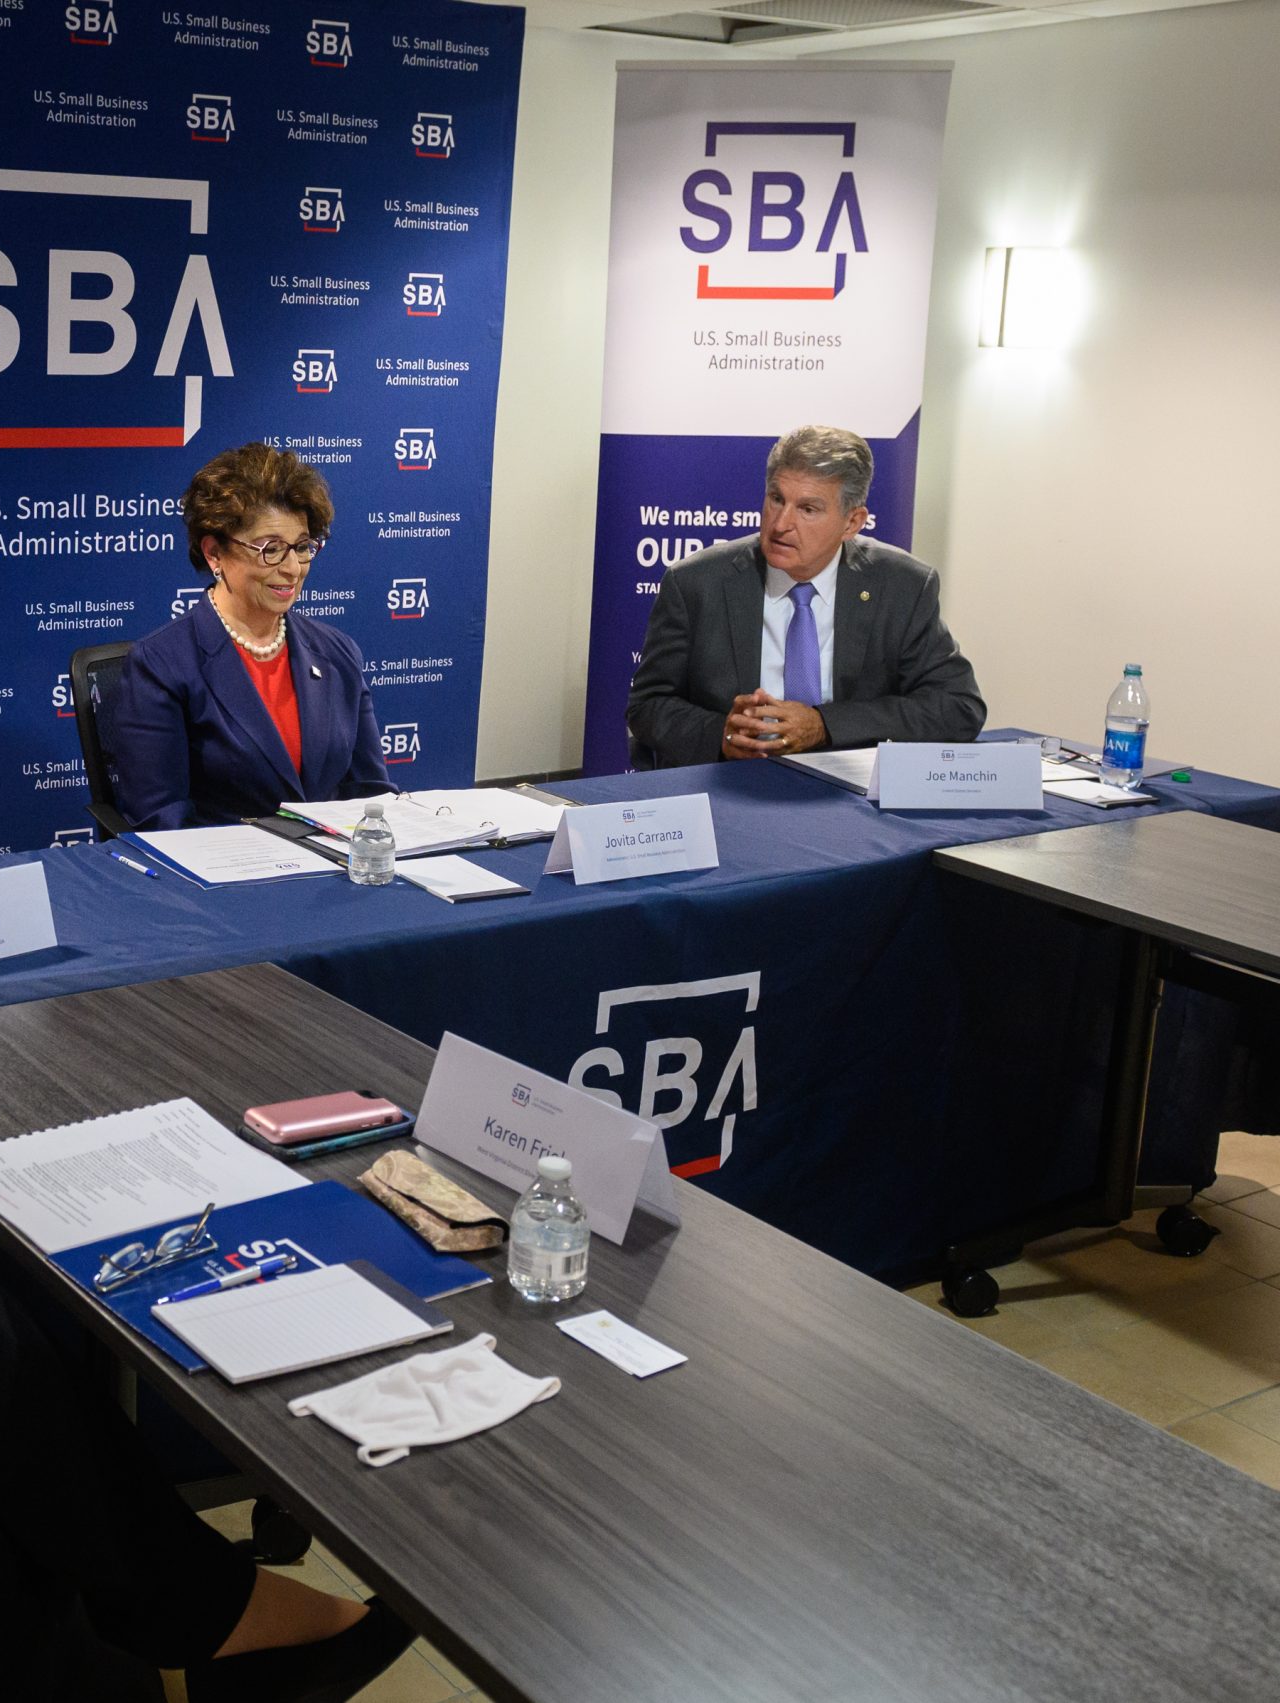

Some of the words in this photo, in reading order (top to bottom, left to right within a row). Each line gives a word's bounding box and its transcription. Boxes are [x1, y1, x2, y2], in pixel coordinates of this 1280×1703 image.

[65, 6, 118, 34] SBA
[306, 30, 353, 57] SBA
[34, 90, 55, 104] U.S.
[59, 92, 92, 106] Small
[96, 95, 148, 110] Business
[46, 110, 136, 127] Administration
[186, 105, 235, 132] SBA
[411, 124, 456, 148] SBA
[298, 198, 345, 222] SBA
[384, 200, 402, 211] U.S.
[405, 201, 433, 213] Small
[436, 202, 479, 216] Business
[680, 169, 869, 253] SBA
[394, 217, 468, 232] Administration
[270, 276, 289, 287] U.S.
[292, 276, 322, 288] Small
[325, 277, 370, 290] Business
[281, 292, 359, 306] Administration
[402, 284, 446, 308] SBA
[694, 330, 719, 346] U.S.
[725, 330, 768, 346] Small
[774, 331, 842, 347] Business
[376, 358, 394, 370] U.S.
[396, 358, 424, 370] Small
[427, 359, 469, 371] Business
[708, 354, 824, 370] Administration
[292, 360, 338, 384] SBA
[386, 374, 458, 386] Administration
[394, 440, 437, 461] SBA
[17, 494, 86, 520] Small
[96, 493, 184, 517] Busines
[368, 512, 386, 523] U.S.
[388, 511, 416, 523] Small
[418, 511, 460, 522] Business
[640, 506, 670, 526] We
[674, 505, 728, 527] make
[378, 526, 450, 538] Administration
[26, 603, 46, 615] U.S.
[49, 601, 82, 614] Small
[85, 600, 134, 612] Business
[387, 589, 429, 610] SBA
[37, 616, 123, 631] Administration
[381, 658, 408, 671] Small
[411, 657, 453, 668] Business
[370, 672, 442, 686] Administration
[926, 771, 946, 781] Joe
[949, 770, 997, 782] Manchin
[605, 834, 636, 848] Jovita
[638, 830, 683, 844] Carranza
[484, 1116, 527, 1152] Karen
